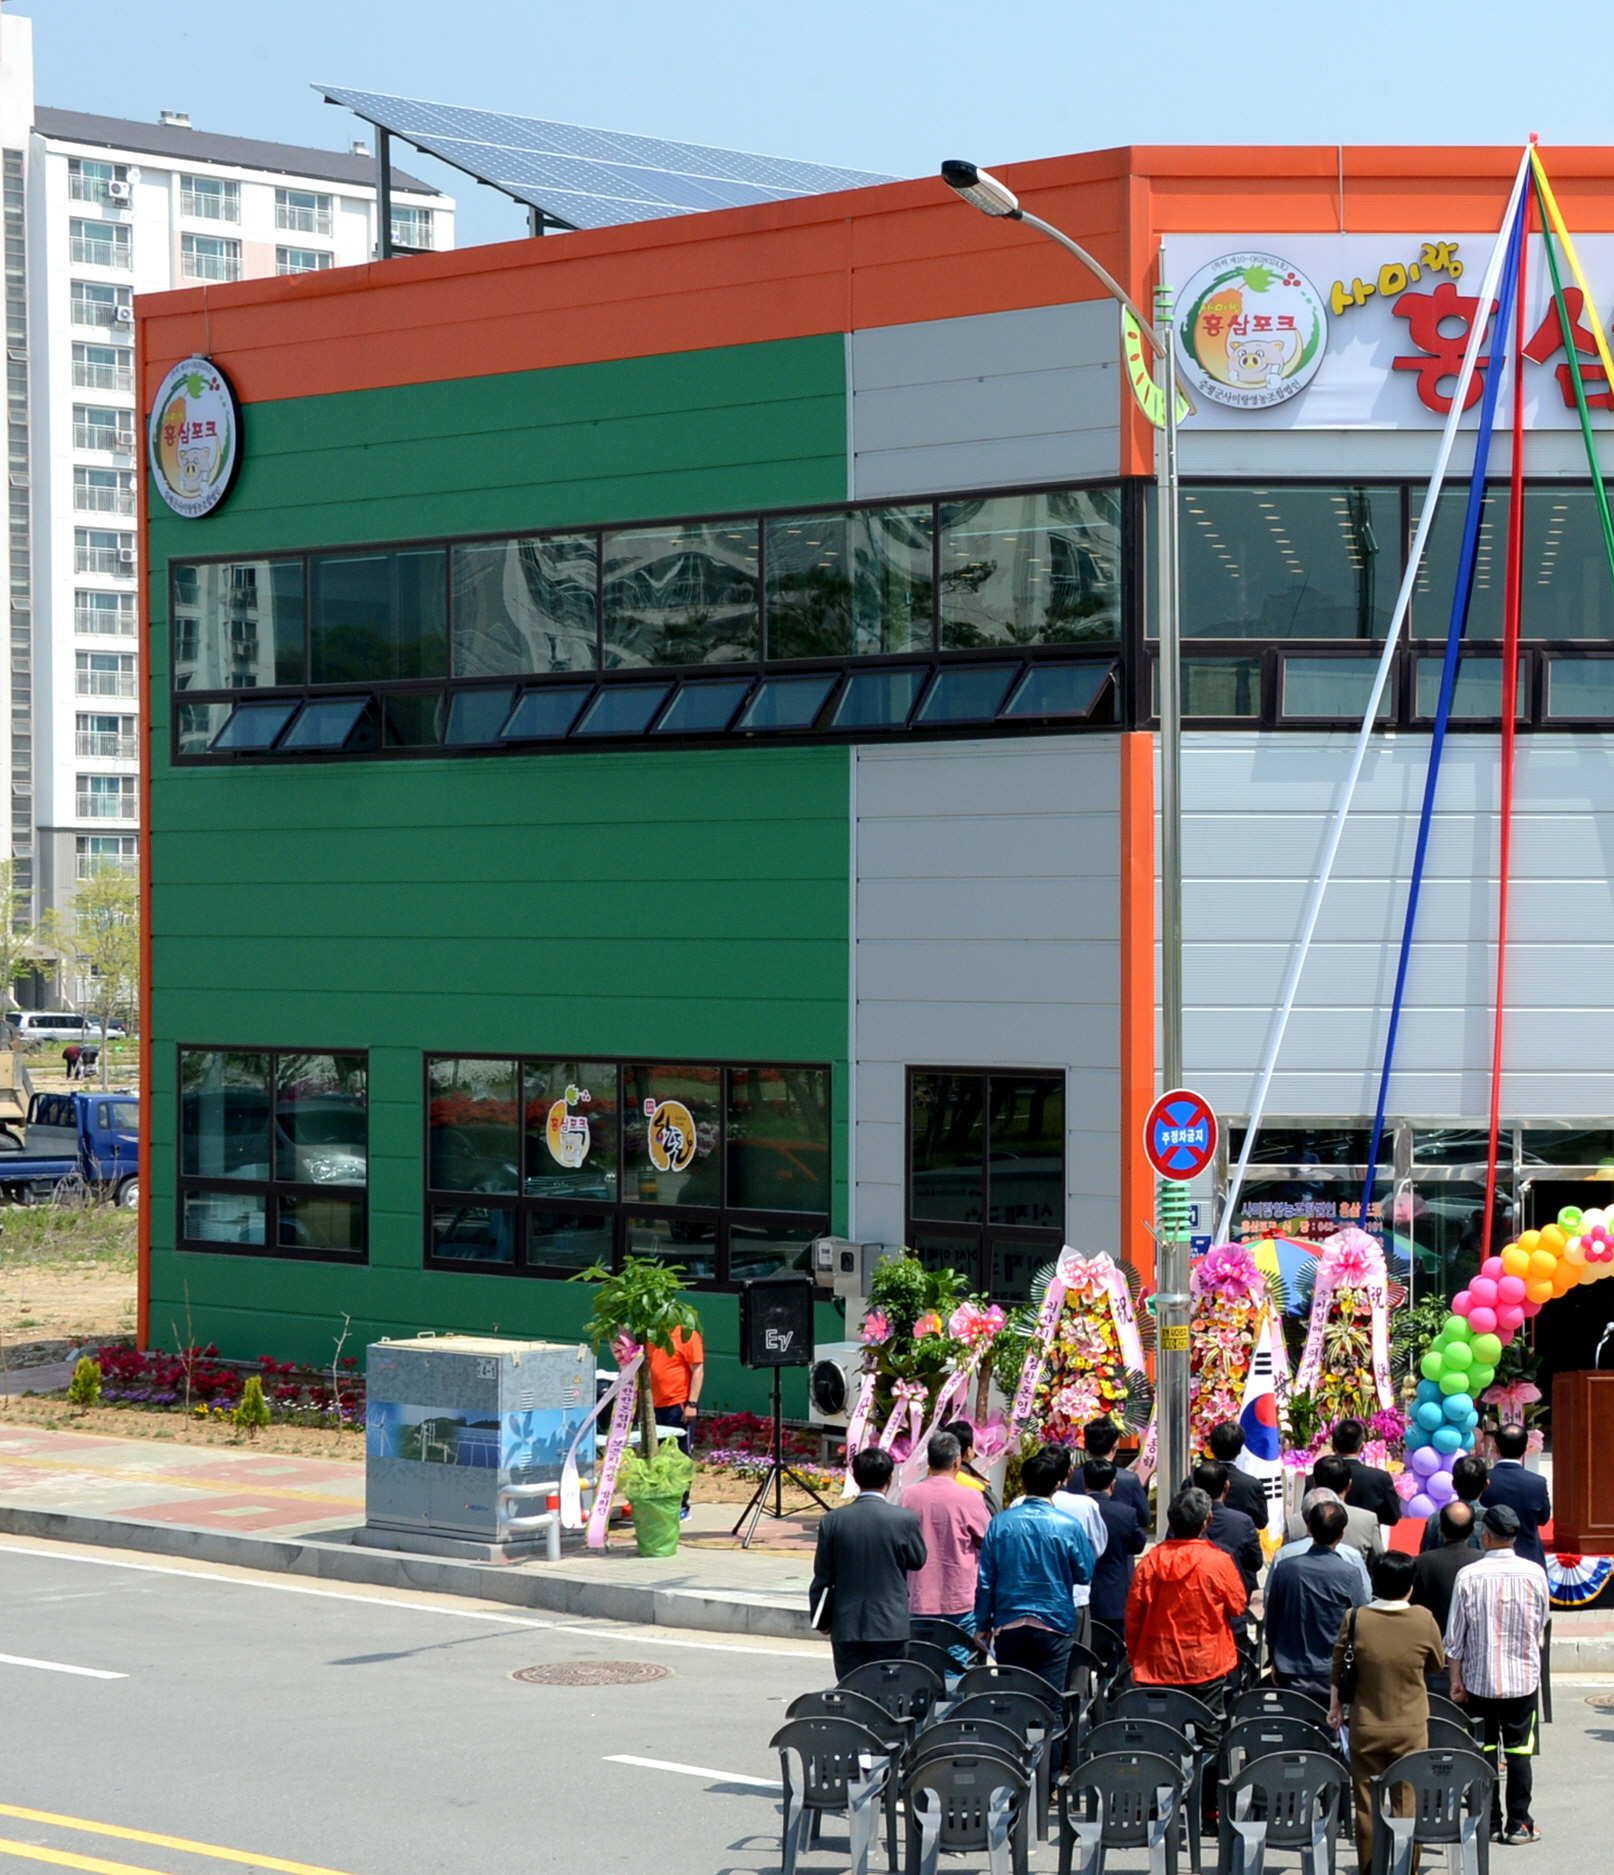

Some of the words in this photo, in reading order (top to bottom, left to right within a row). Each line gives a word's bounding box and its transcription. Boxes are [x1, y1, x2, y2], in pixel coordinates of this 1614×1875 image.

[1330, 241, 1463, 316] 사미랑
[1202, 314, 1297, 337] 홍삼포크
[164, 421, 217, 447] 홍삼포크
[1161, 1128, 1204, 1146] 주정차금지
[1339, 1201, 1383, 1219] 홍삼크
